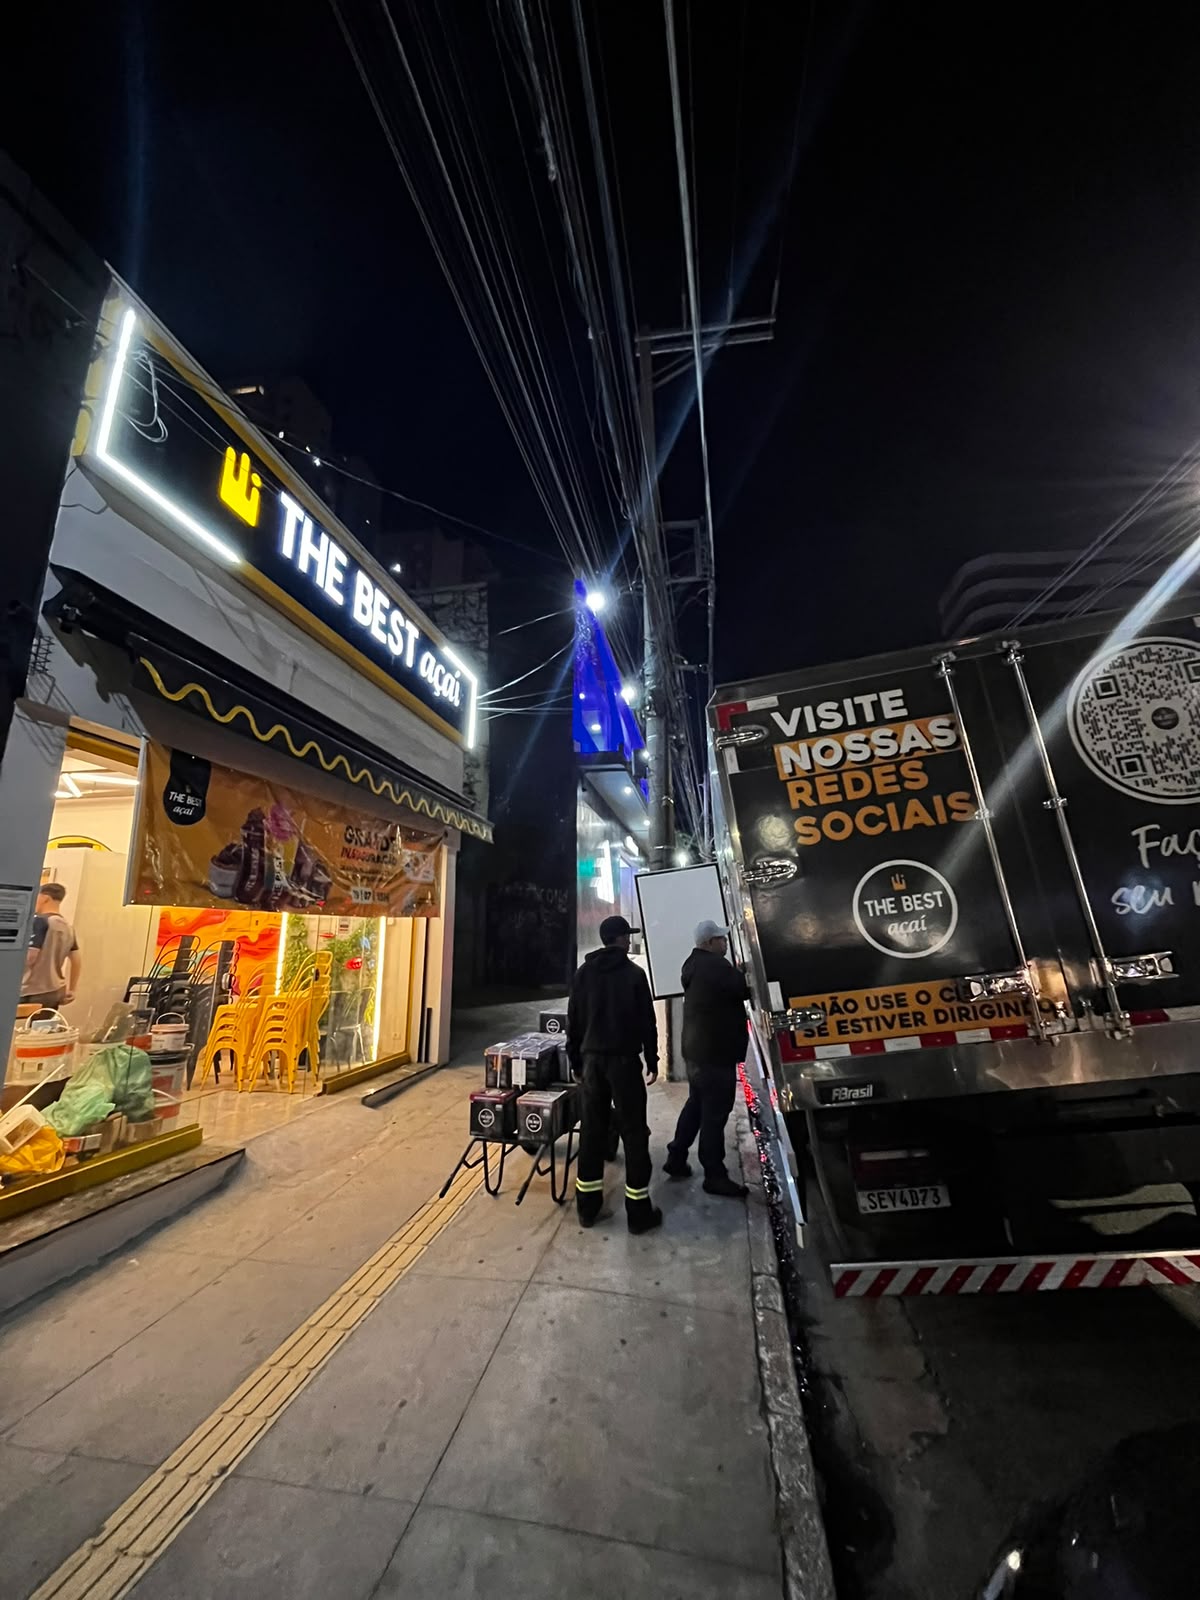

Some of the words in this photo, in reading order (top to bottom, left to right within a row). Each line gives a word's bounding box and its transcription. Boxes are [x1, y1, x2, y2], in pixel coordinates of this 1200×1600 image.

[280, 490, 348, 606] THE
[353, 570, 420, 668] BEST
[770, 688, 908, 737] VISITE
[776, 717, 958, 775] NOSSAS
[169, 791, 186, 803] THE
[786, 760, 929, 810] REDES
[793, 791, 976, 846] SOCIAIS
[863, 897, 899, 917] THE
[901, 890, 943, 913] BEST
[1110, 884, 1175, 915] seu
[811, 996, 859, 1017] NÃO
[865, 991, 909, 1011] USE
[914, 989, 932, 1006] O
[836, 1011, 928, 1036] ESTIVER
[867, 1187, 942, 1211] SEY4D73
